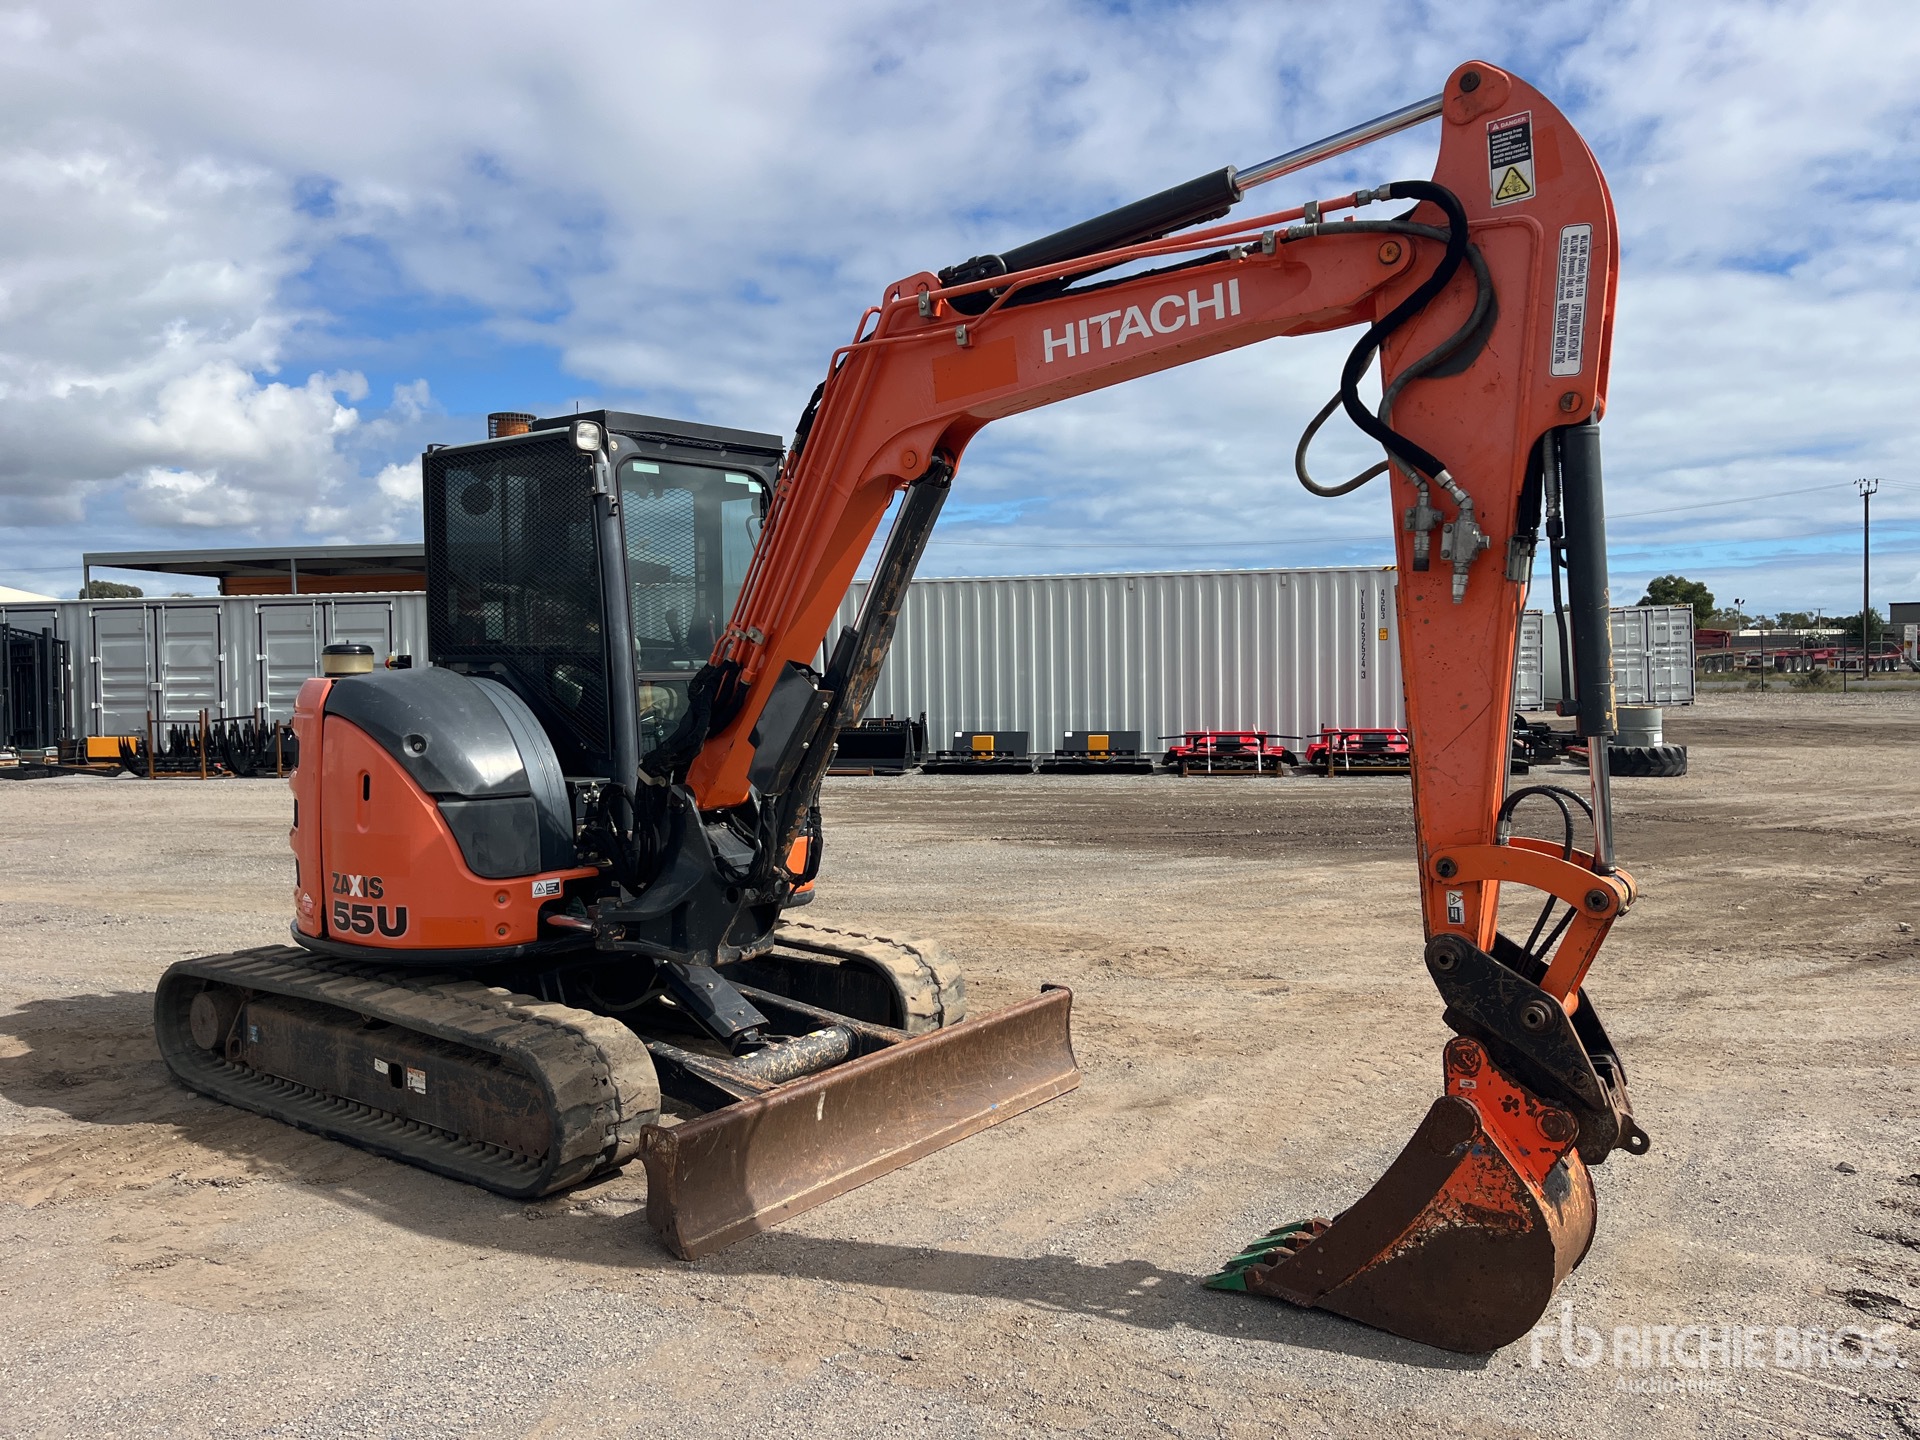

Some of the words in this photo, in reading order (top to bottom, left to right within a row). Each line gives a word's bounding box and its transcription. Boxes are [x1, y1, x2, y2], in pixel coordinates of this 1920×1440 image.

[1500, 117, 1526, 128] DANGER
[1043, 278, 1241, 363] HITACHI
[332, 872, 384, 899] ZAXIS
[334, 900, 408, 938] 55U
